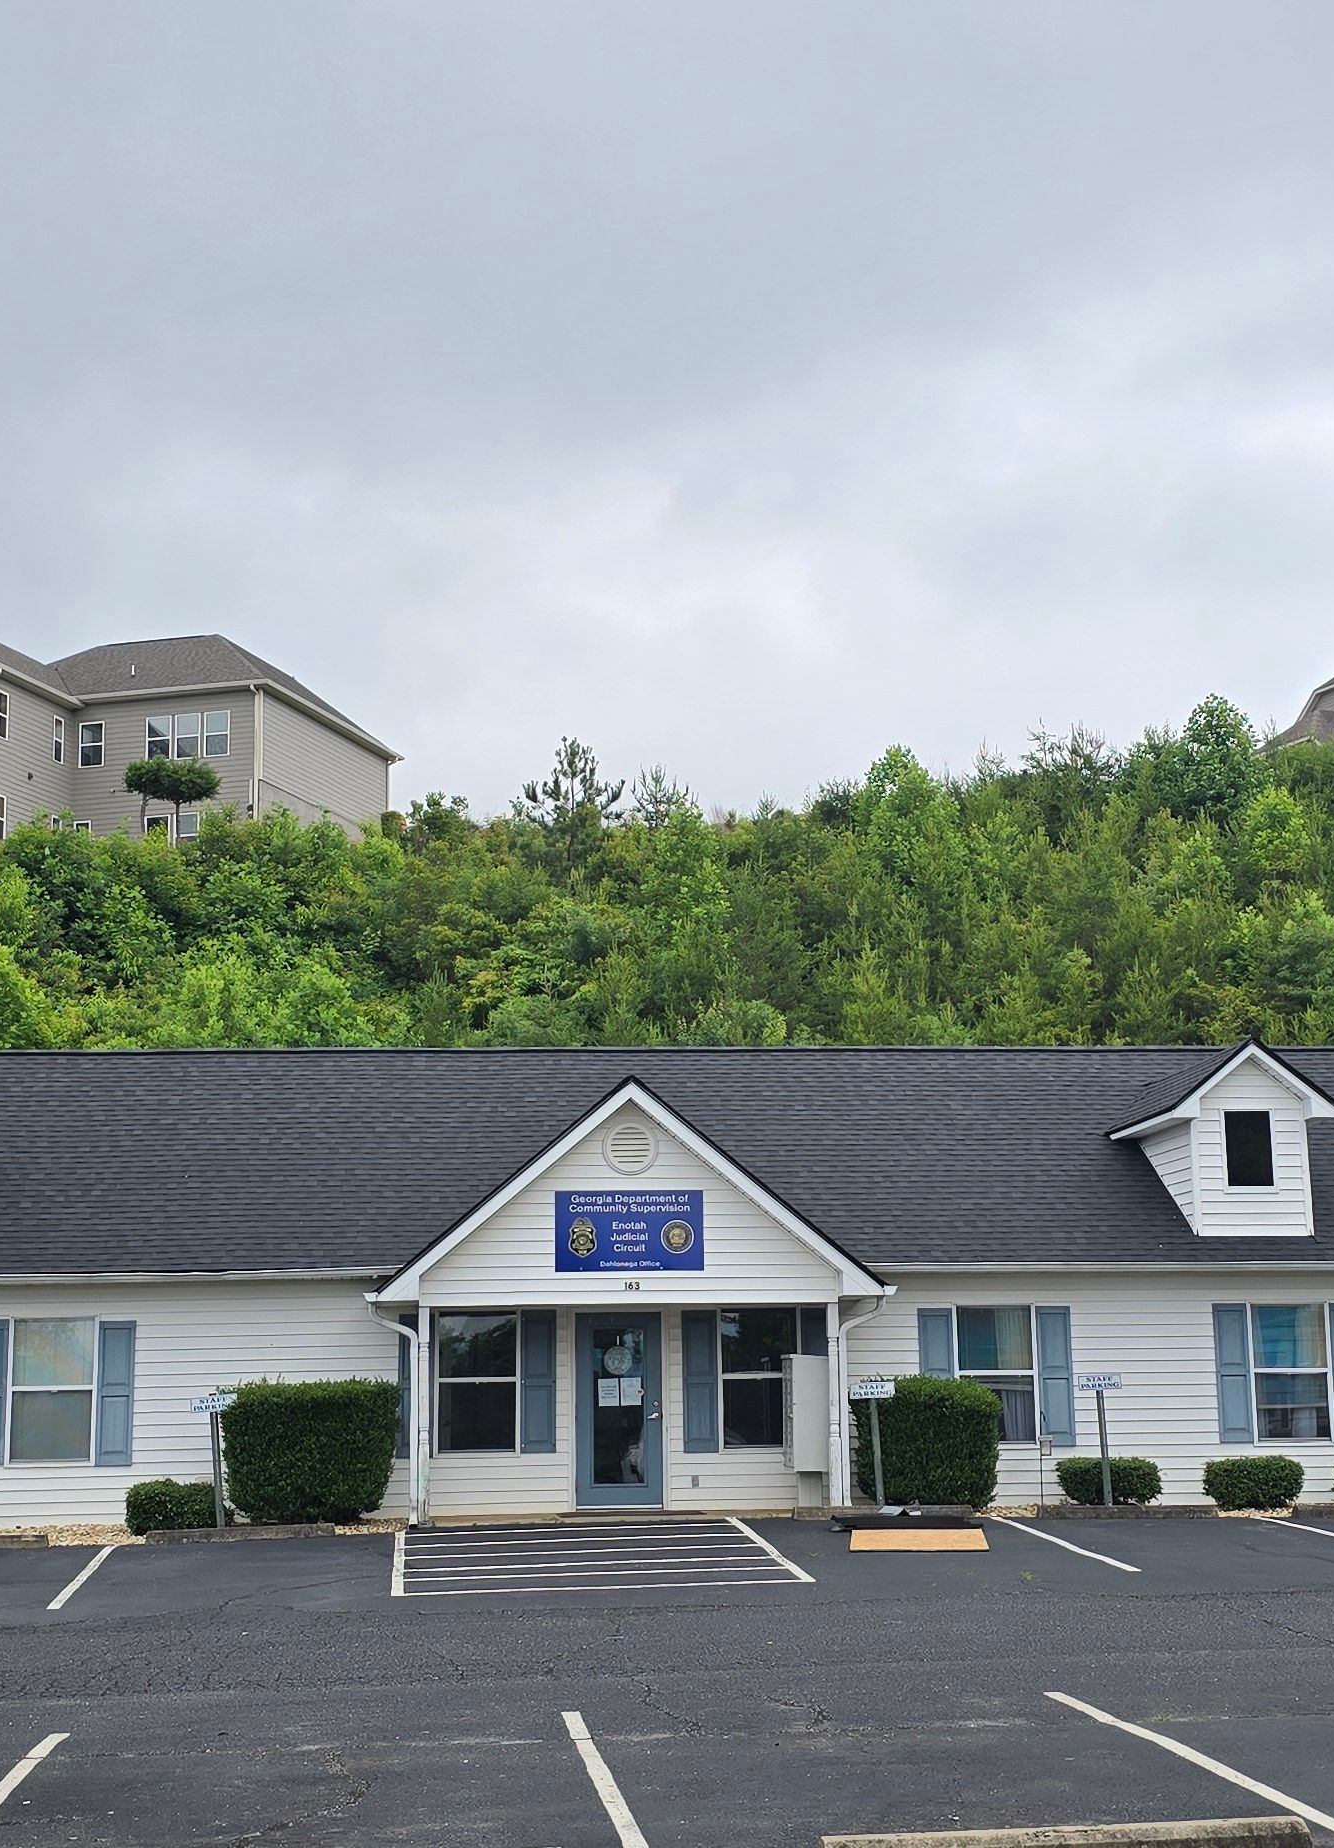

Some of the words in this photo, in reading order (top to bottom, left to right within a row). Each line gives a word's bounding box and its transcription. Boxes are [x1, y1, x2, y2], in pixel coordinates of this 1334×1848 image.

[571, 1194, 612, 1204] Georgia
[615, 1194, 676, 1204] Department
[678, 1194, 689, 1203] of
[569, 1204, 628, 1214] Community
[630, 1203, 691, 1214] Supervision
[612, 1221, 647, 1230] Enotah
[610, 1232, 649, 1241] Judicial
[613, 1243, 646, 1252] Circuit
[600, 1260, 638, 1268] Dahlonega
[624, 1281, 640, 1291] 163
[193, 1402, 231, 1411] PARKIN
